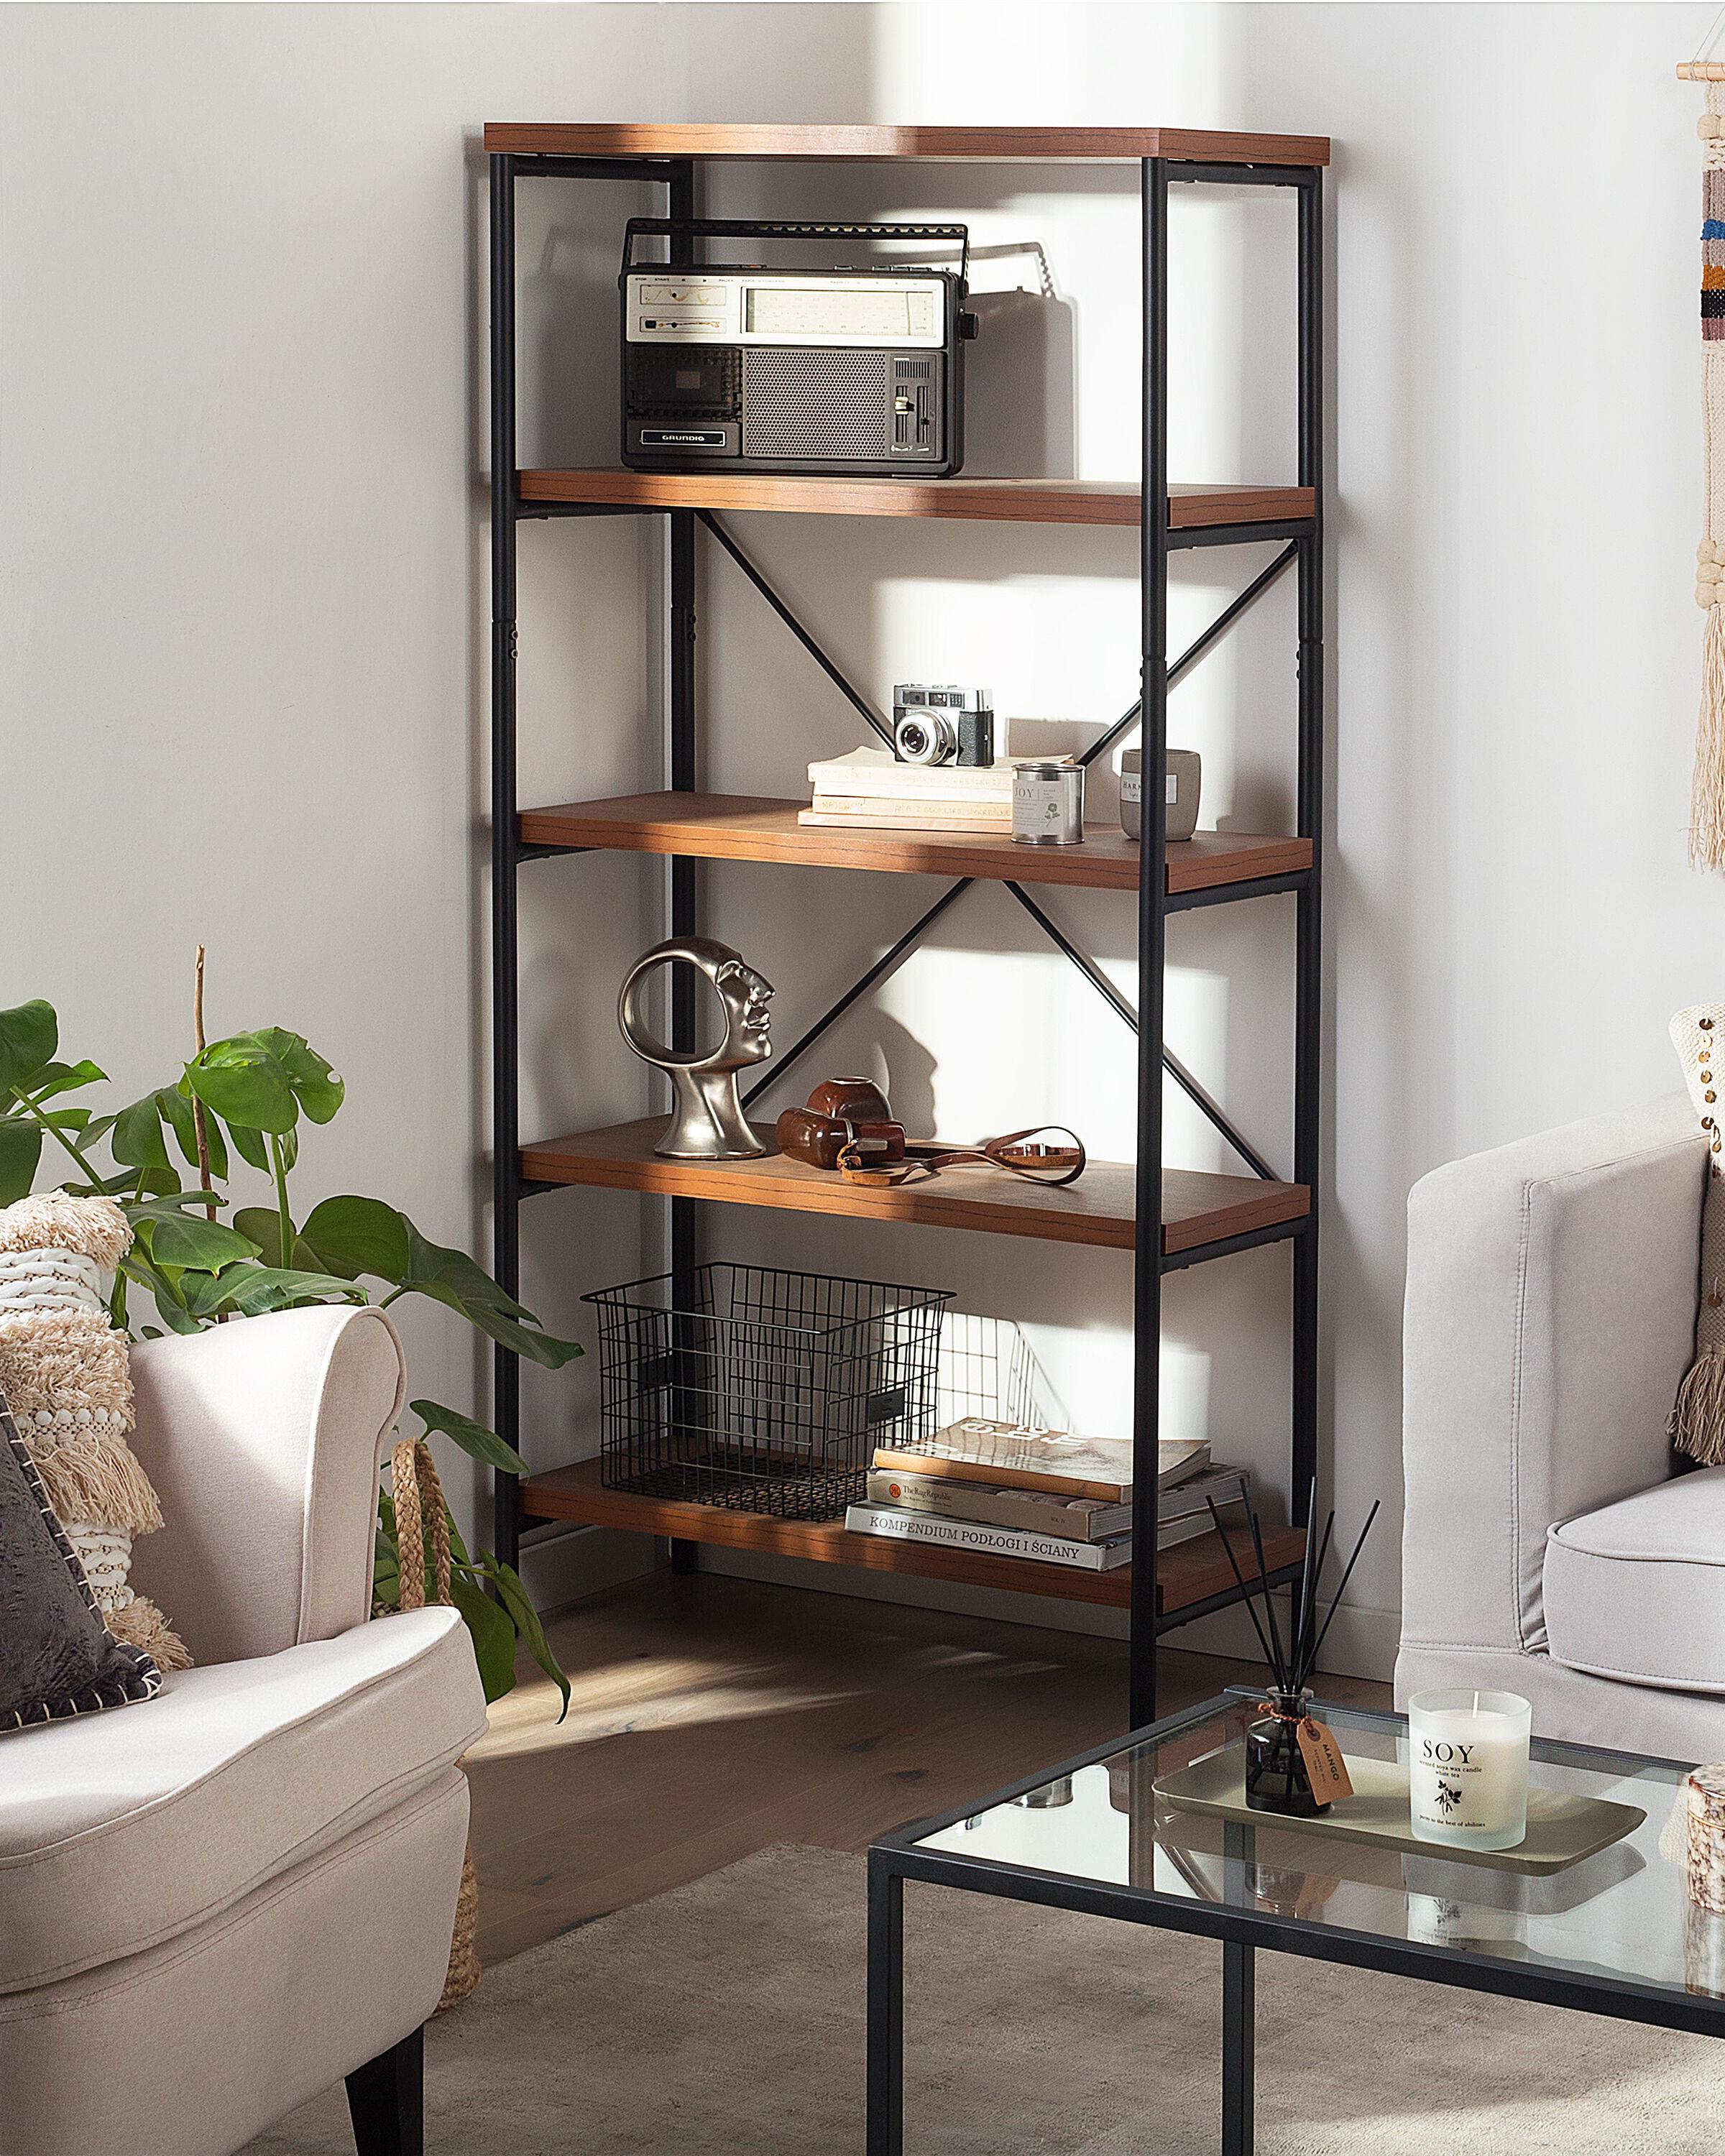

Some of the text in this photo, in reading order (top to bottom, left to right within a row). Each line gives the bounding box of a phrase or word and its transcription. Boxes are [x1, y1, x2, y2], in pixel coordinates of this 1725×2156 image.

[1015, 788, 1034, 798] JOY
[870, 1516, 1080, 1560] KOMPENDIUM PODŁOGI I ŚCIANY
[1322, 1743, 1340, 1782] MANGO
[1423, 1738, 1475, 1764] SOY
